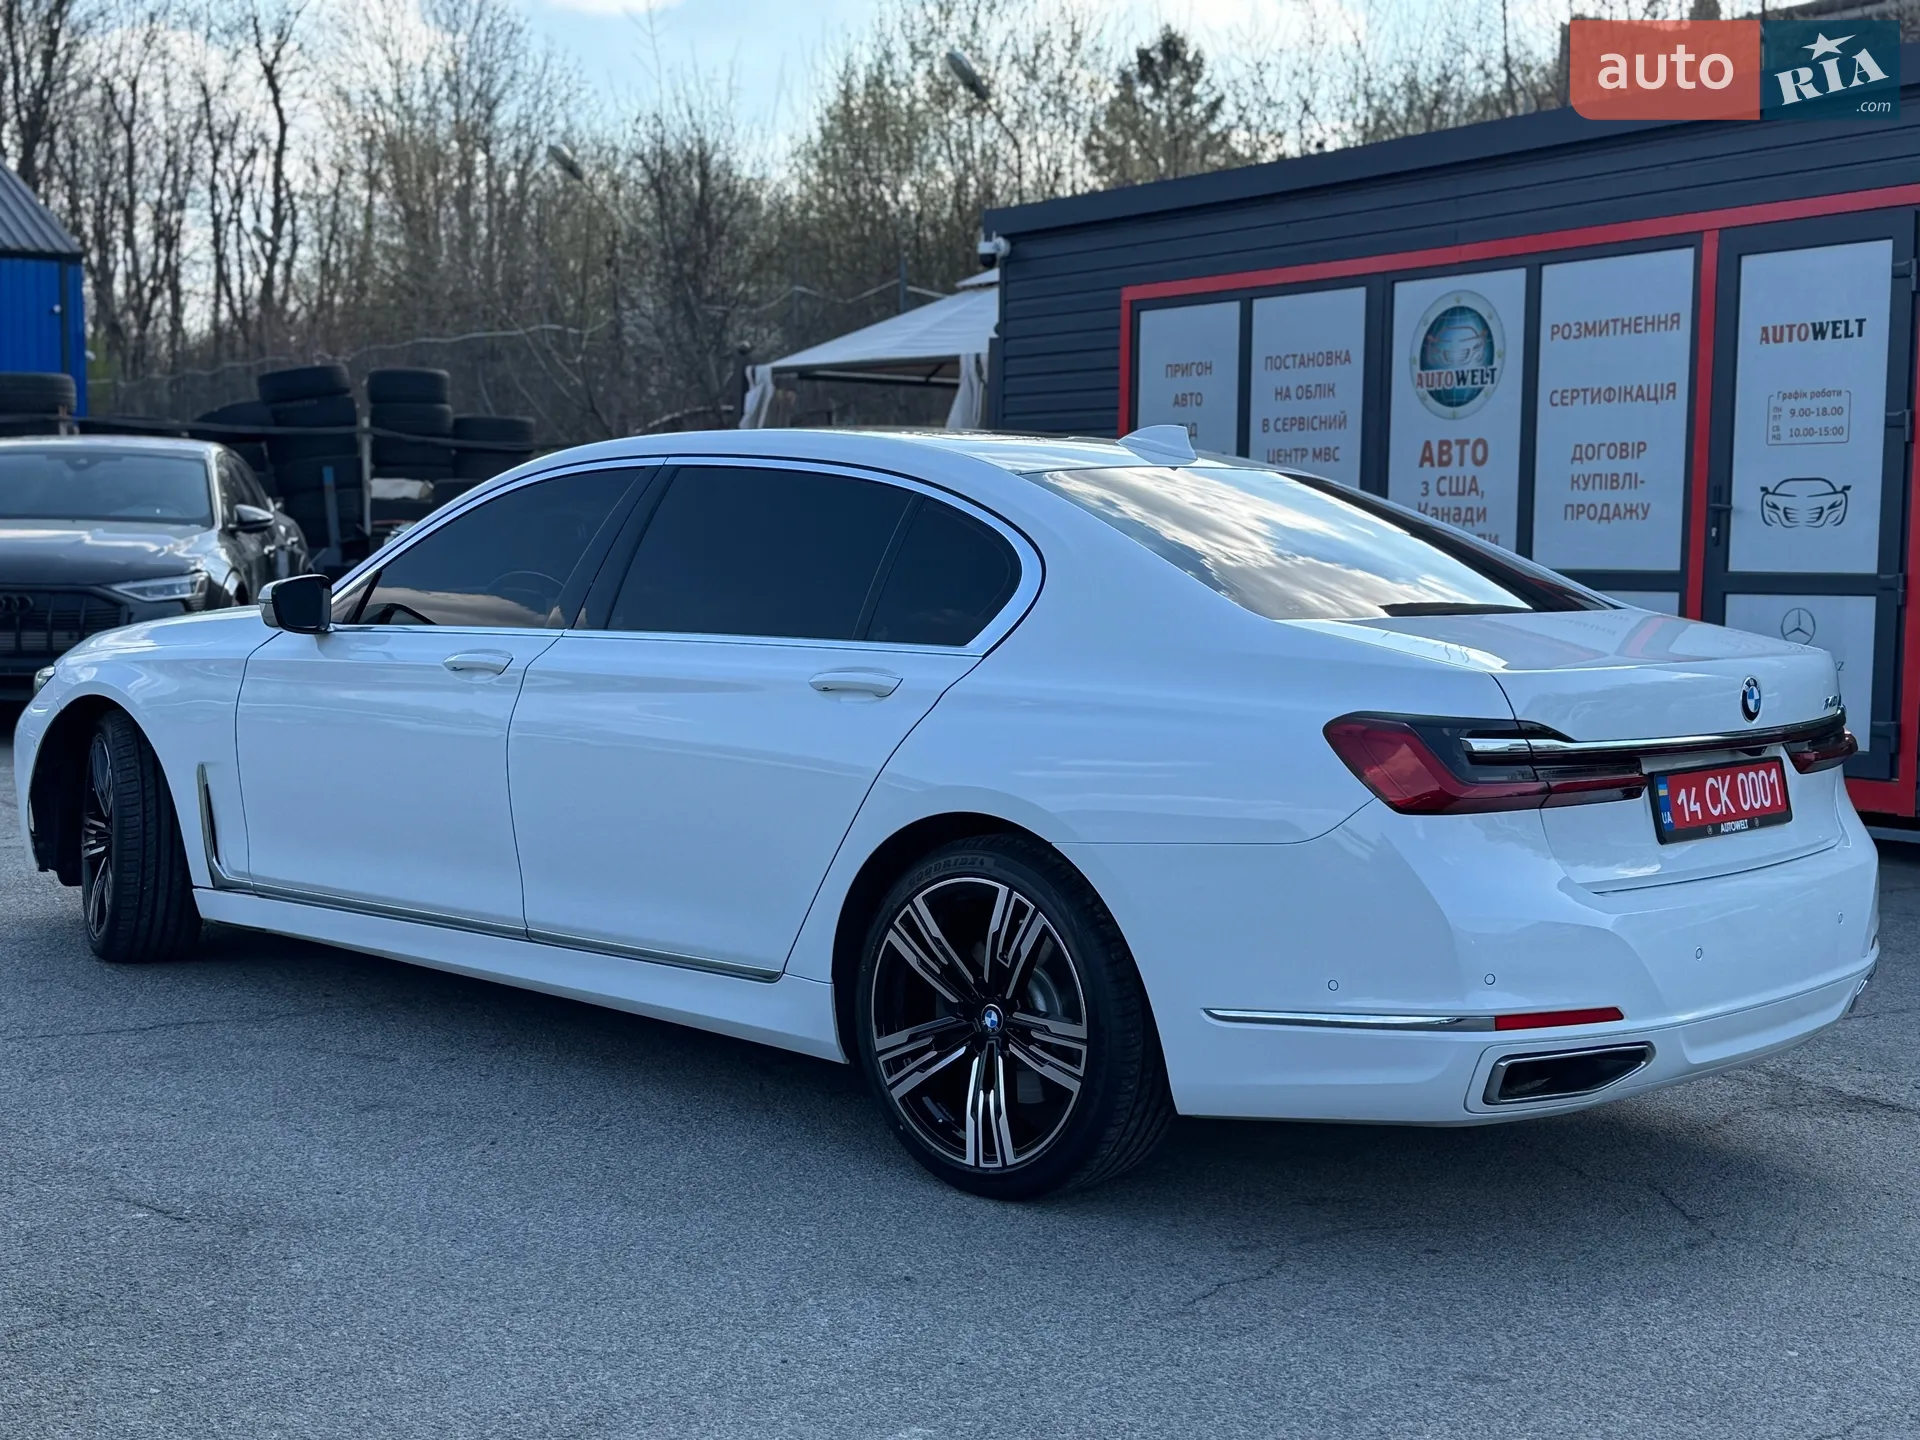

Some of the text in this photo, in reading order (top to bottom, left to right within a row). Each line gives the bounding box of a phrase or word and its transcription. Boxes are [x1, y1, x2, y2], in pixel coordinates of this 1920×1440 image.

[1550, 312, 1681, 341] РОЗМИТНЕННЯ
[1760, 318, 1867, 345] AUTOWELT
[1165, 361, 1213, 378] ПРИГОН
[1264, 349, 1352, 371] ПОСТАНОВКА
[1416, 367, 1498, 389] AUTOWELT
[1173, 392, 1204, 408] АВТО
[1275, 383, 1336, 401] НА ОБЛІК
[1549, 382, 1677, 408] СЕРТИФІКАЦІЯ
[1777, 388, 1842, 402] Графік роботи
[1262, 411, 1348, 434] В СЕРВІСНИЙ
[1789, 406, 1844, 418] 9.00-18.00
[1266, 446, 1341, 465] ЦЕНТР МВС
[1418, 437, 1489, 468] АВТО
[1570, 441, 1648, 465] ДОГОВІР
[1436, 475, 1485, 498] США,
[1570, 472, 1646, 491] КУПІВЛІ-
[1564, 502, 1651, 524] ПРОДАЖУ
[1677, 787, 1702, 822] 14
[1737, 768, 1782, 811] 0001
[1662, 811, 1673, 824] UA
